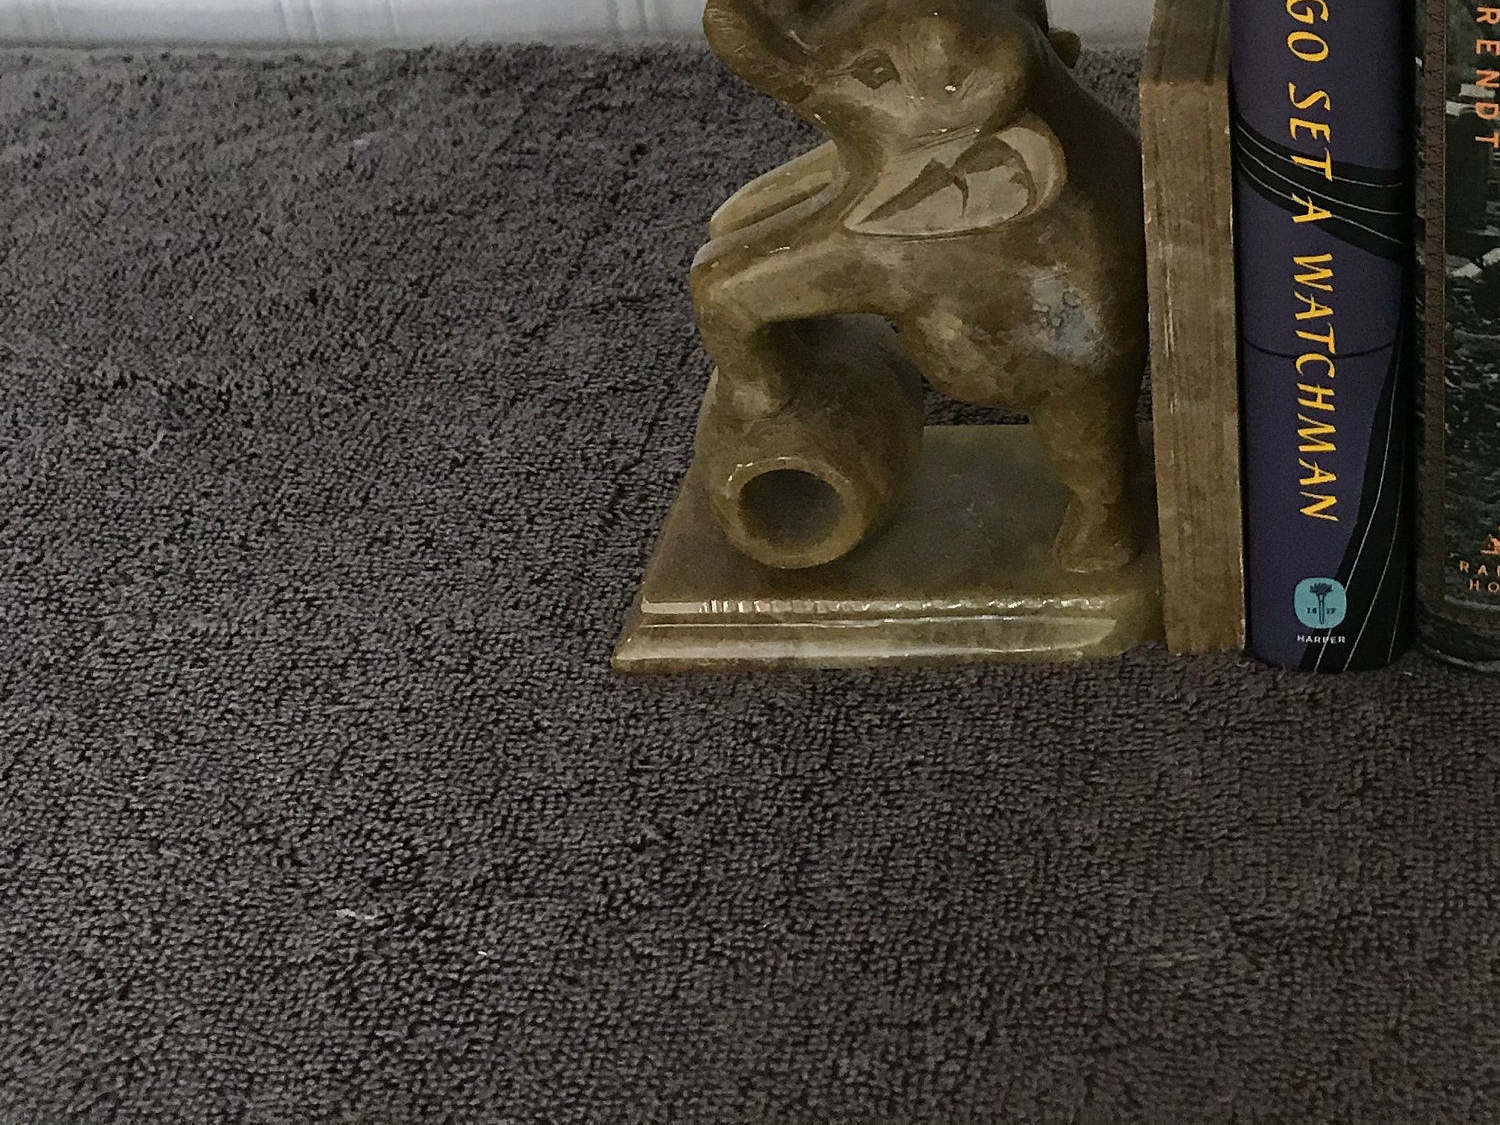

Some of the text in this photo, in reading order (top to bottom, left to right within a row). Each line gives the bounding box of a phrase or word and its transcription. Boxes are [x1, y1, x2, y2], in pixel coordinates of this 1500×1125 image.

[1288, 82, 1333, 181] SET
[1292, 194, 1332, 224] A
[1293, 253, 1338, 521] WATCHMAN
[1296, 634, 1346, 644] HARPER
